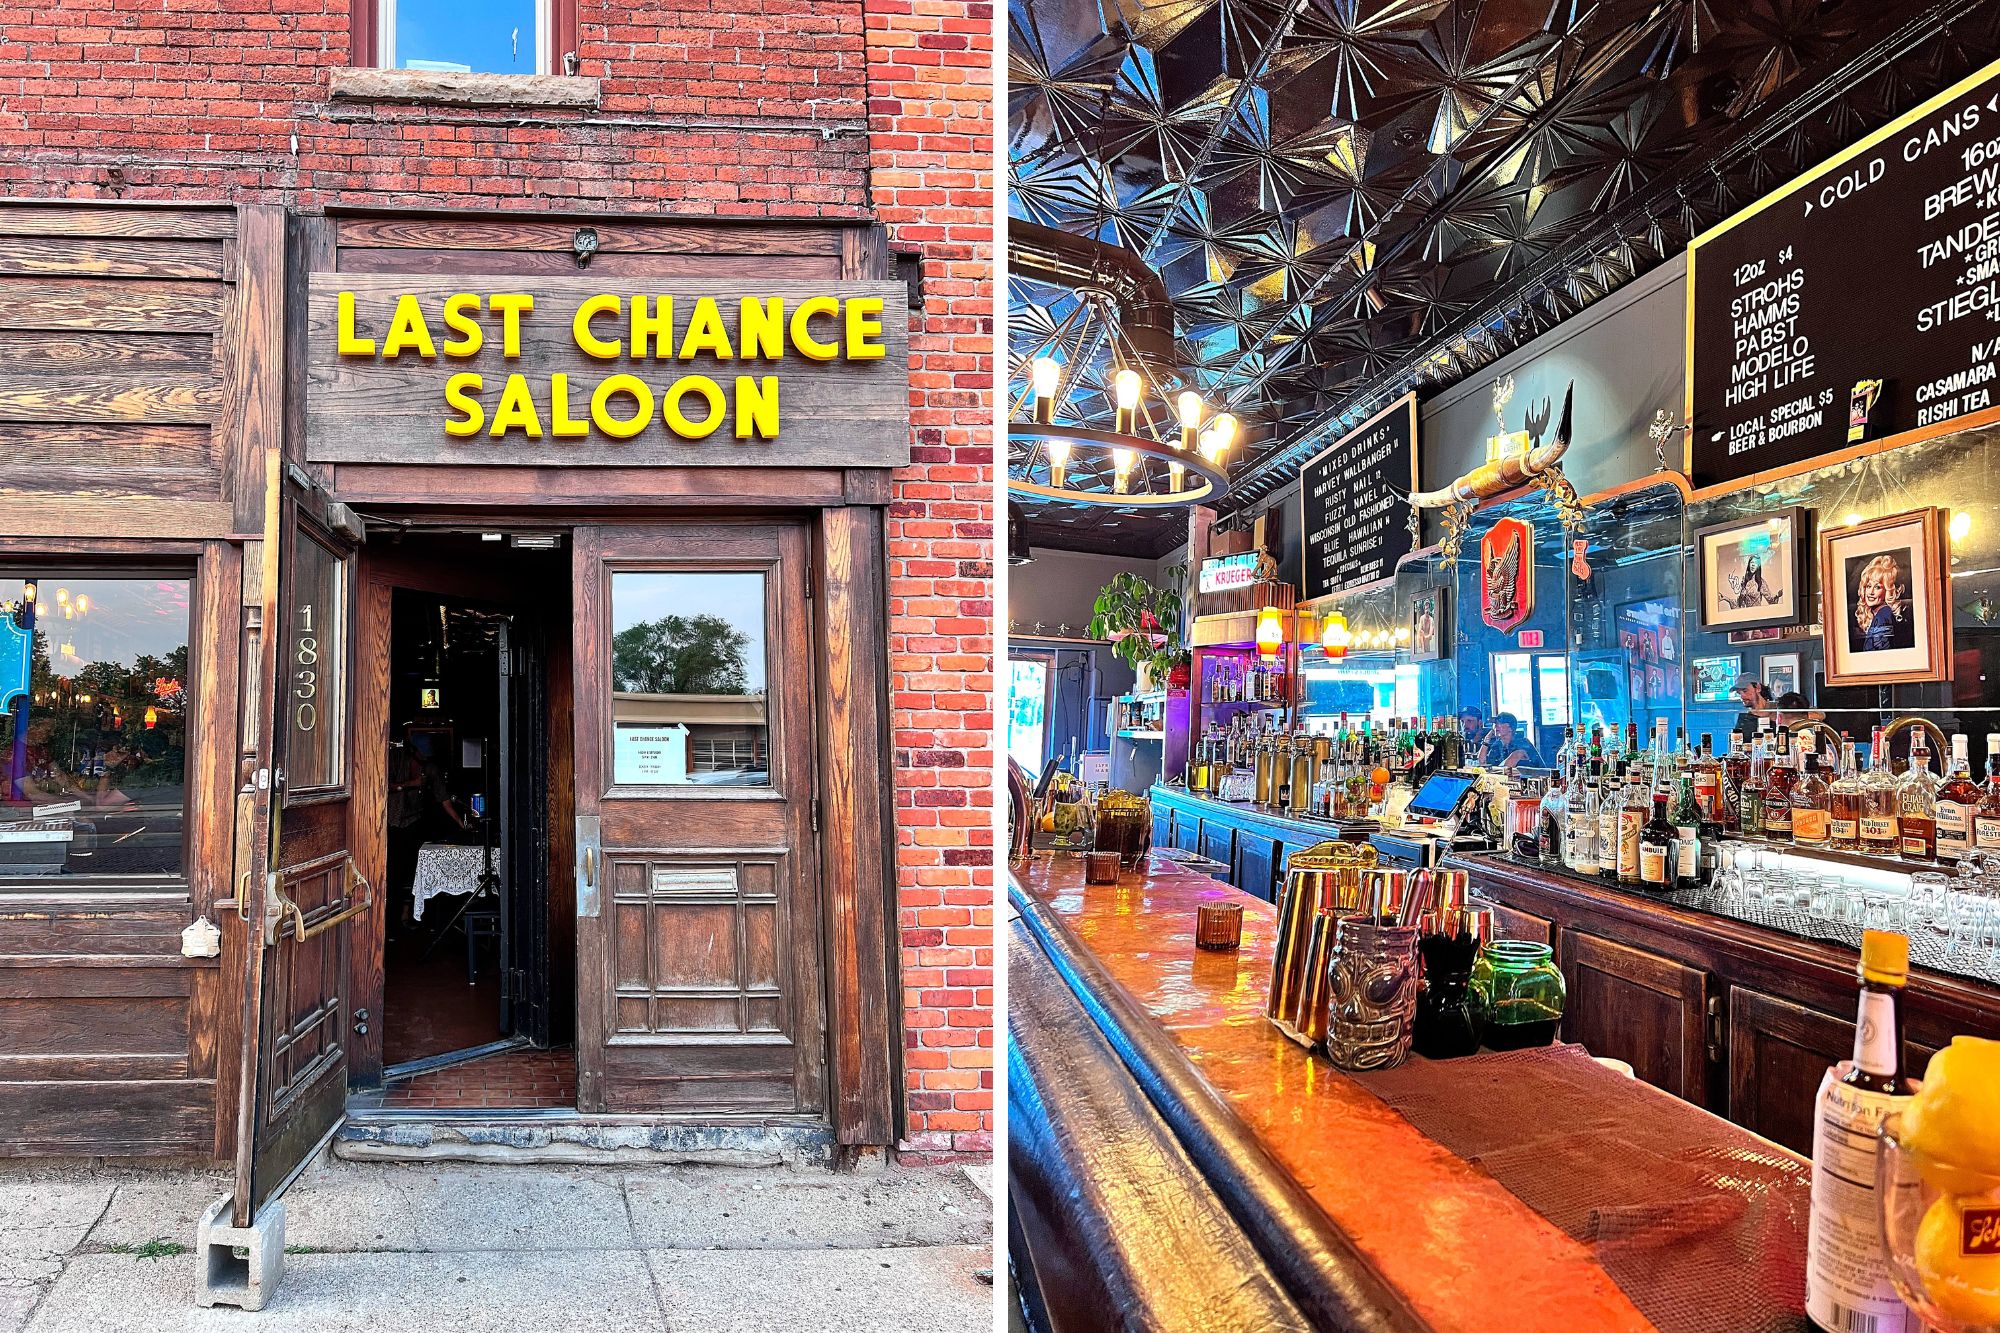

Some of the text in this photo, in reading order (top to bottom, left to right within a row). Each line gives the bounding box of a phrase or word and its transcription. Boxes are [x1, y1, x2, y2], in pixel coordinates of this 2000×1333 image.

[1819, 104, 1980, 209] COLD CANS
[1733, 245, 1793, 288] 12oz $4
[1730, 268, 1804, 319] STROHS
[1734, 293, 1801, 340] HAMMS
[1916, 280, 2000, 332] STIEGL
[338, 292, 886, 361] LAST CHANCE
[1735, 315, 1799, 360] PABST
[1725, 355, 1816, 408] HIGH LIFE
[1731, 336, 1809, 384] MODELO
[1916, 361, 1997, 403] CASAMARA
[444, 372, 780, 440] SALOON
[1730, 388, 1834, 441] LOCAL SPECIAL $5
[1918, 388, 1991, 427] RISHI TEA
[1351, 427, 1385, 459] DRINKS
[1728, 433, 1756, 456] BEER
[1758, 431, 1766, 446] &
[1768, 411, 1823, 442] BOURBON
[1314, 473, 1340, 499] HARVEY
[1343, 443, 1392, 481] WALLBANGER
[1325, 487, 1346, 509] RUSTY
[1353, 474, 1373, 494] NAIL
[1309, 494, 1395, 545] WISCONSIN OLD FASHIONED
[1324, 503, 1347, 525] FUZZY
[1353, 487, 1378, 510] NAVEL
[1322, 549, 1348, 569] TEQUILA
[1349, 535, 1378, 557] SUNRISE
[1323, 537, 1340, 554] BLUE
[1348, 517, 1383, 544] HAWAIIAN
[1215, 567, 1252, 586] KRUEGER
[296, 604, 317, 731] 1830
[1865, 827, 1881, 835] 101
